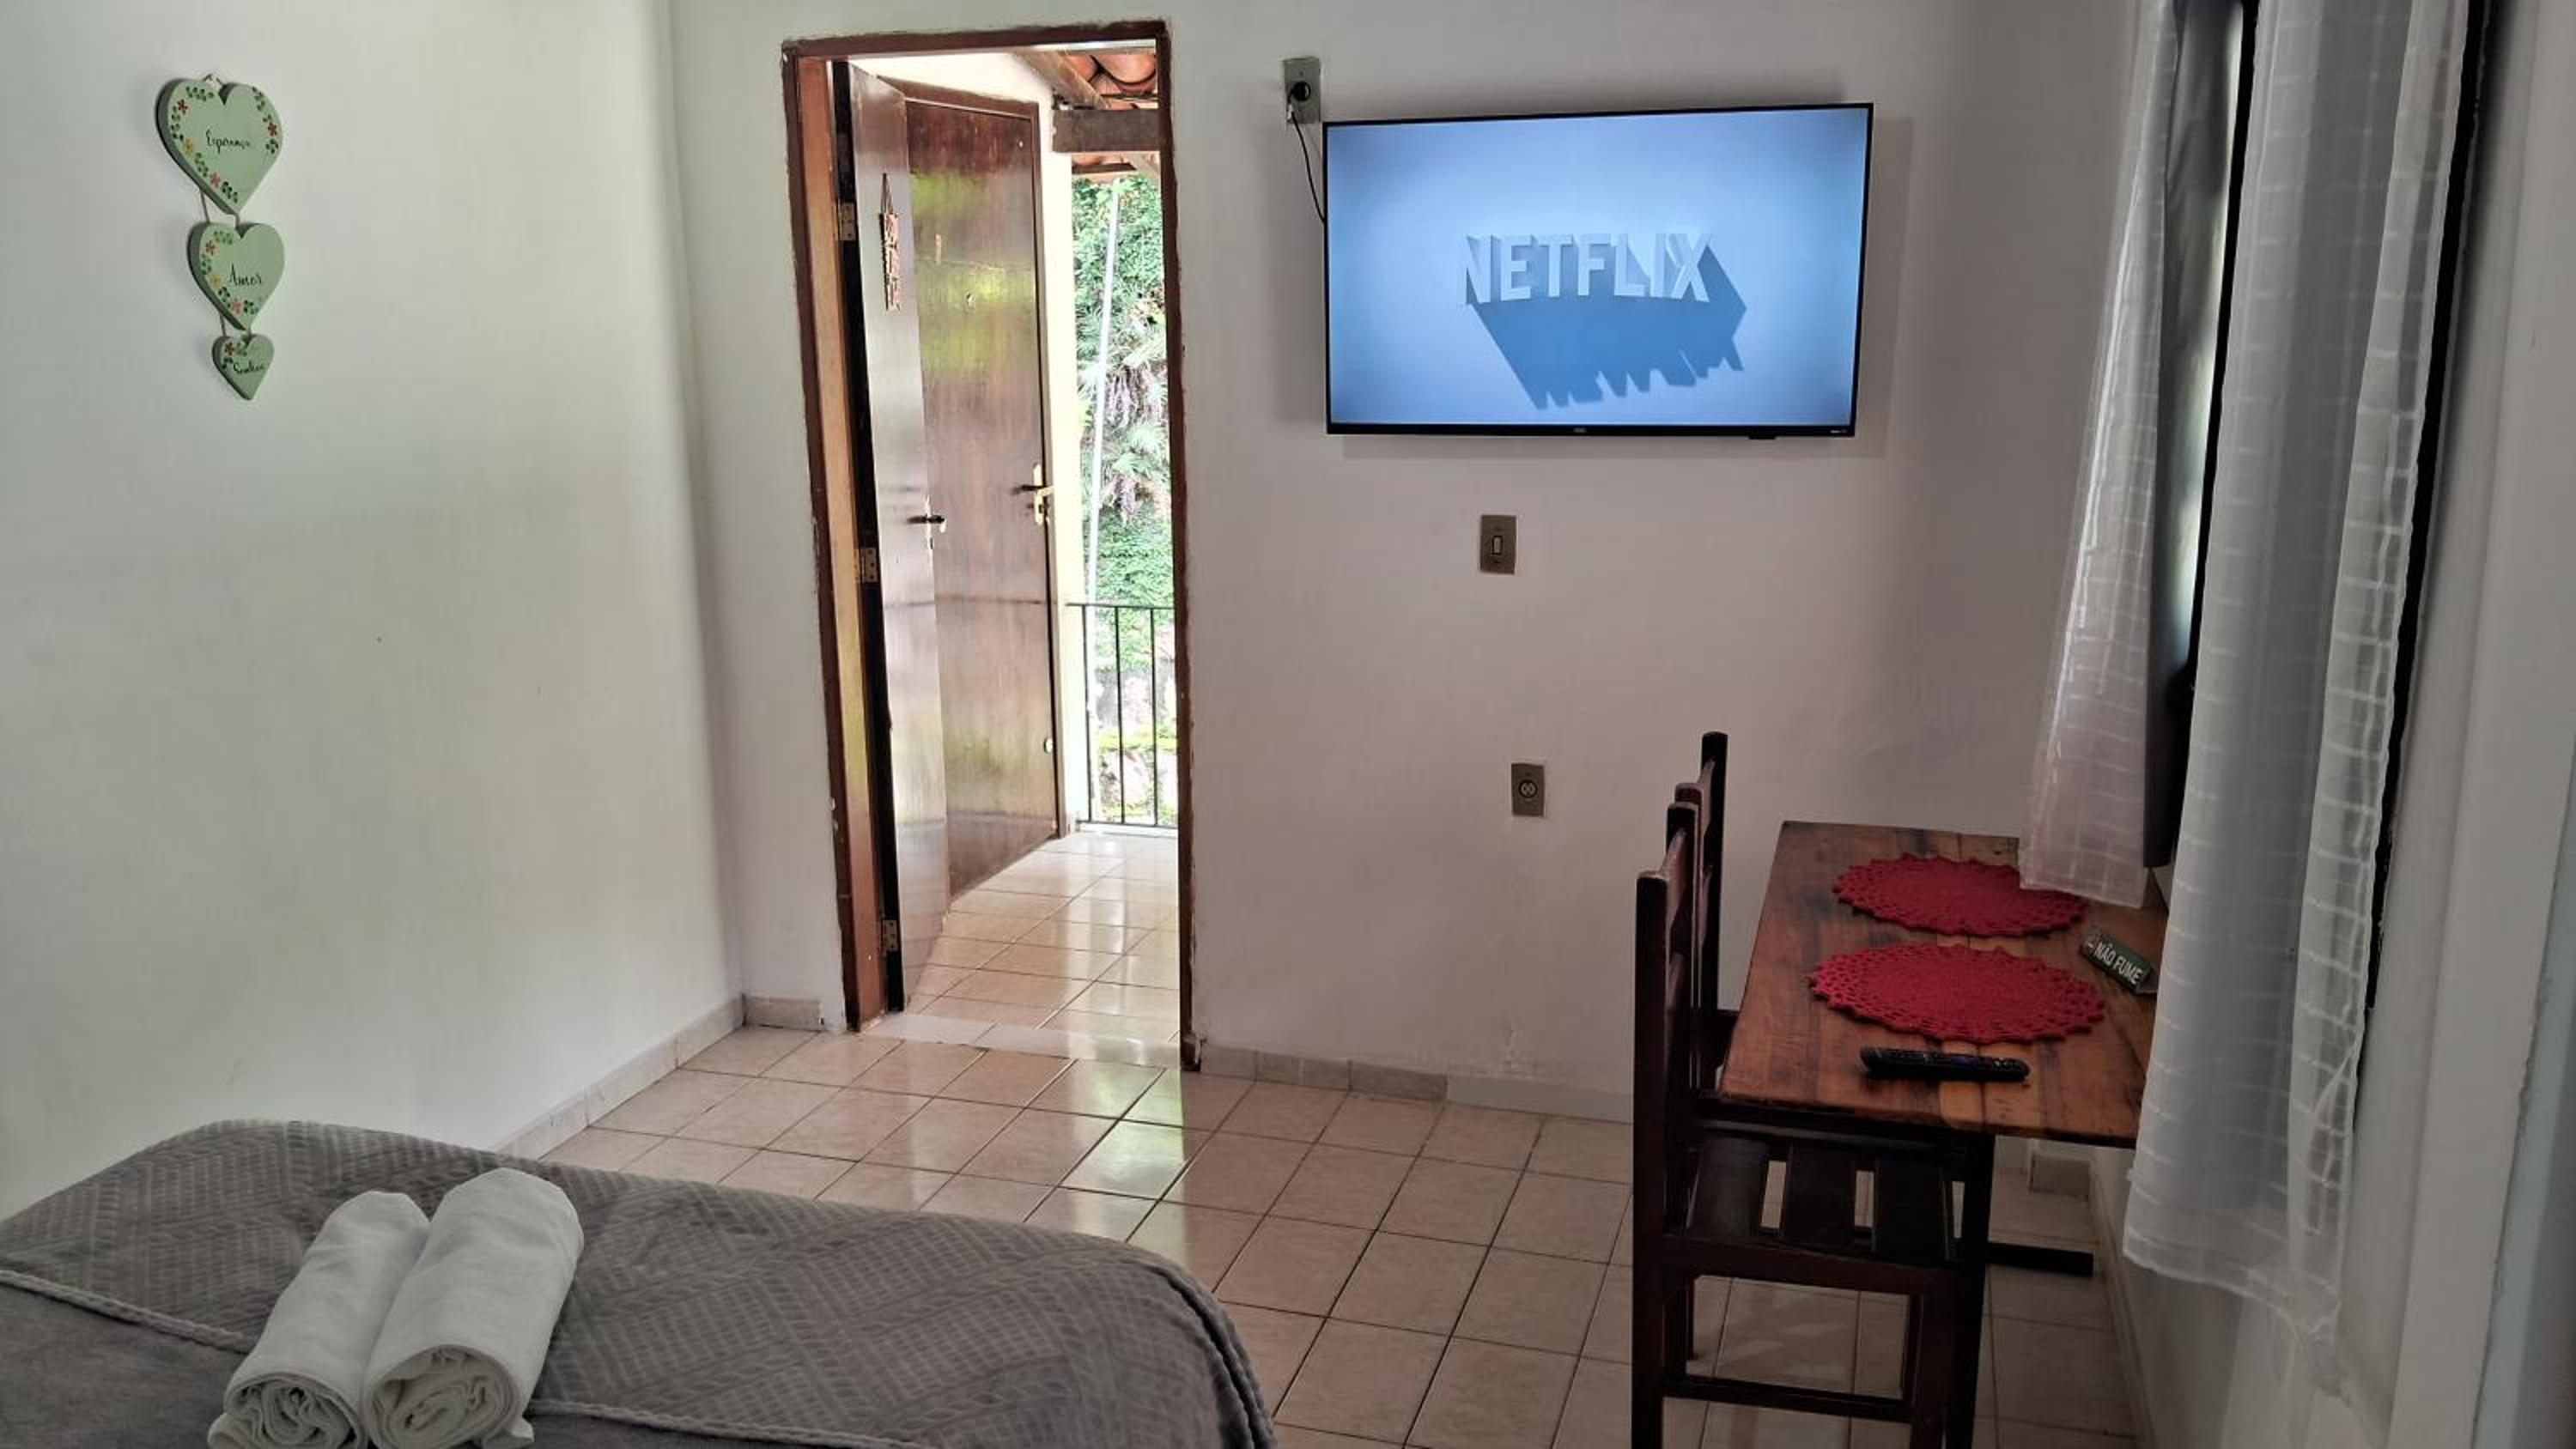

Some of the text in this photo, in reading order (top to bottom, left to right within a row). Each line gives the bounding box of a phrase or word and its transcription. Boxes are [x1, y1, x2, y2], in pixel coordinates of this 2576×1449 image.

[228, 263, 262, 286] Amor
[1464, 233, 1713, 306] NETFLIX
[2094, 942, 2144, 985] NÃO FUME
